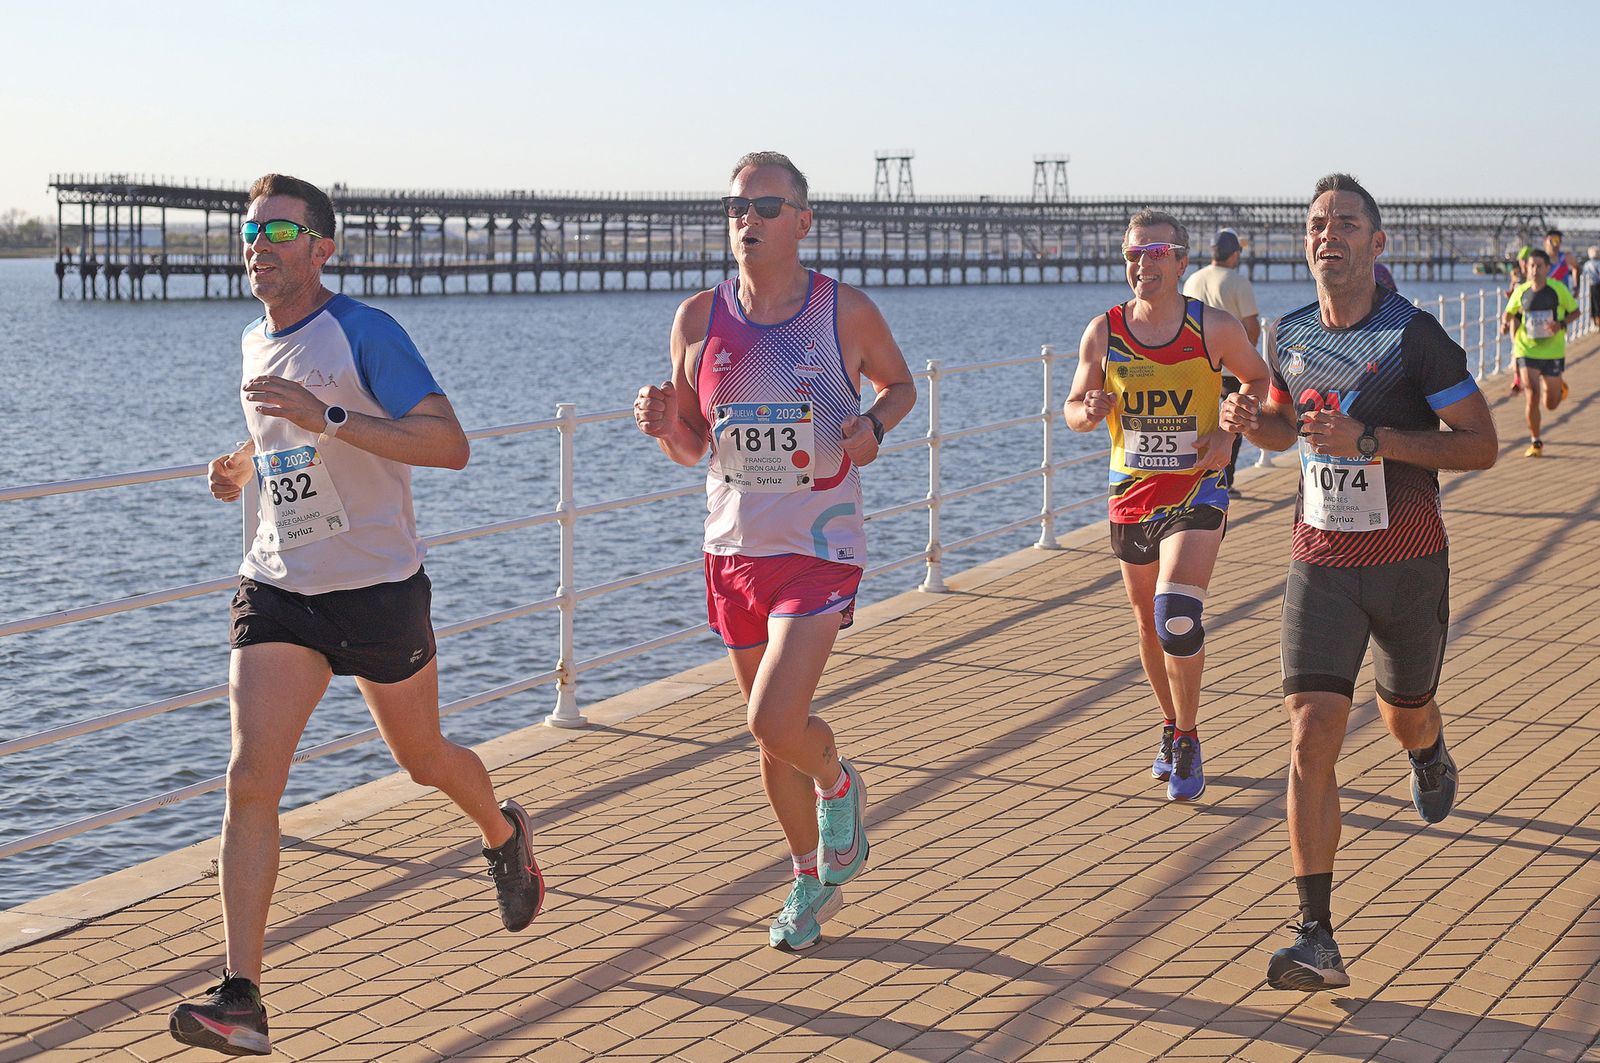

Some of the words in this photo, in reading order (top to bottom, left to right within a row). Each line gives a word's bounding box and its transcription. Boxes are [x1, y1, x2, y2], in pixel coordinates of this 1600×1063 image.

[1123, 389, 1193, 416] UPV
[776, 408, 803, 420] 2023
[730, 427, 797, 452] 1813
[1138, 434, 1178, 453] 325
[284, 451, 311, 468] 2023
[756, 476, 783, 486] Syrluz
[1310, 464, 1369, 492] 1074
[281, 508, 296, 518] JUAN
[1329, 514, 1355, 524] Syrluz
[287, 527, 314, 540] Syrluz
